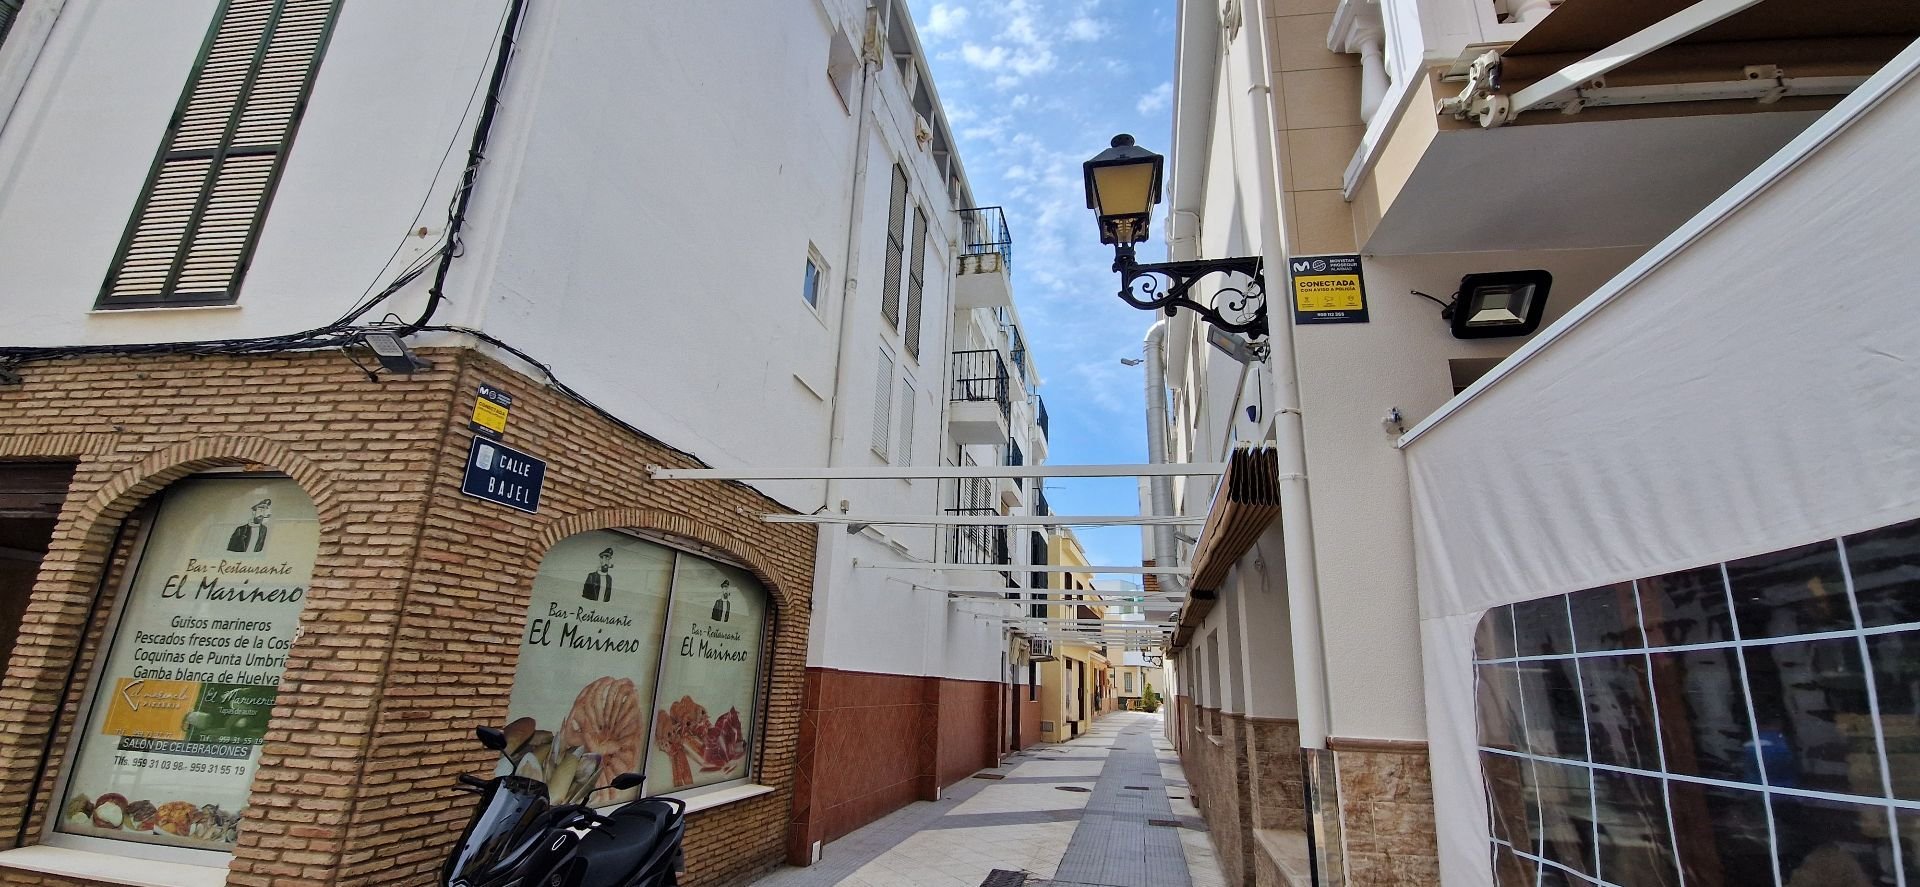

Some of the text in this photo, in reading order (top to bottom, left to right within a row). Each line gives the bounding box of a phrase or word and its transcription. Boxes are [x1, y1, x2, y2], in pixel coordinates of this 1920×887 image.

[500, 456, 530, 477] CALLE
[488, 476, 529, 504] BAJEL
[162, 574, 304, 603] El Marinero
[171, 616, 272, 632] Guisos marineros
[134, 630, 292, 650] Pescados frescos de la Cos
[528, 618, 640, 653] El Marinero
[134, 648, 186, 666] Coquinas
[188, 650, 204, 664] de
[206, 652, 242, 666] Punta
[680, 636, 748, 662] El Marinero
[134, 666, 280, 686] Gamba blanca de Huelva
[204, 687, 218, 703] El
[155, 740, 169, 751] DE
[170, 742, 248, 756] CELEBRACIONES
[132, 758, 148, 768] 959
[148, 759, 159, 768] 31
[160, 760, 171, 770] 03
[190, 762, 206, 773] 959
[208, 764, 218, 774] 31
[220, 765, 232, 774] 55
[234, 766, 246, 776] 19
